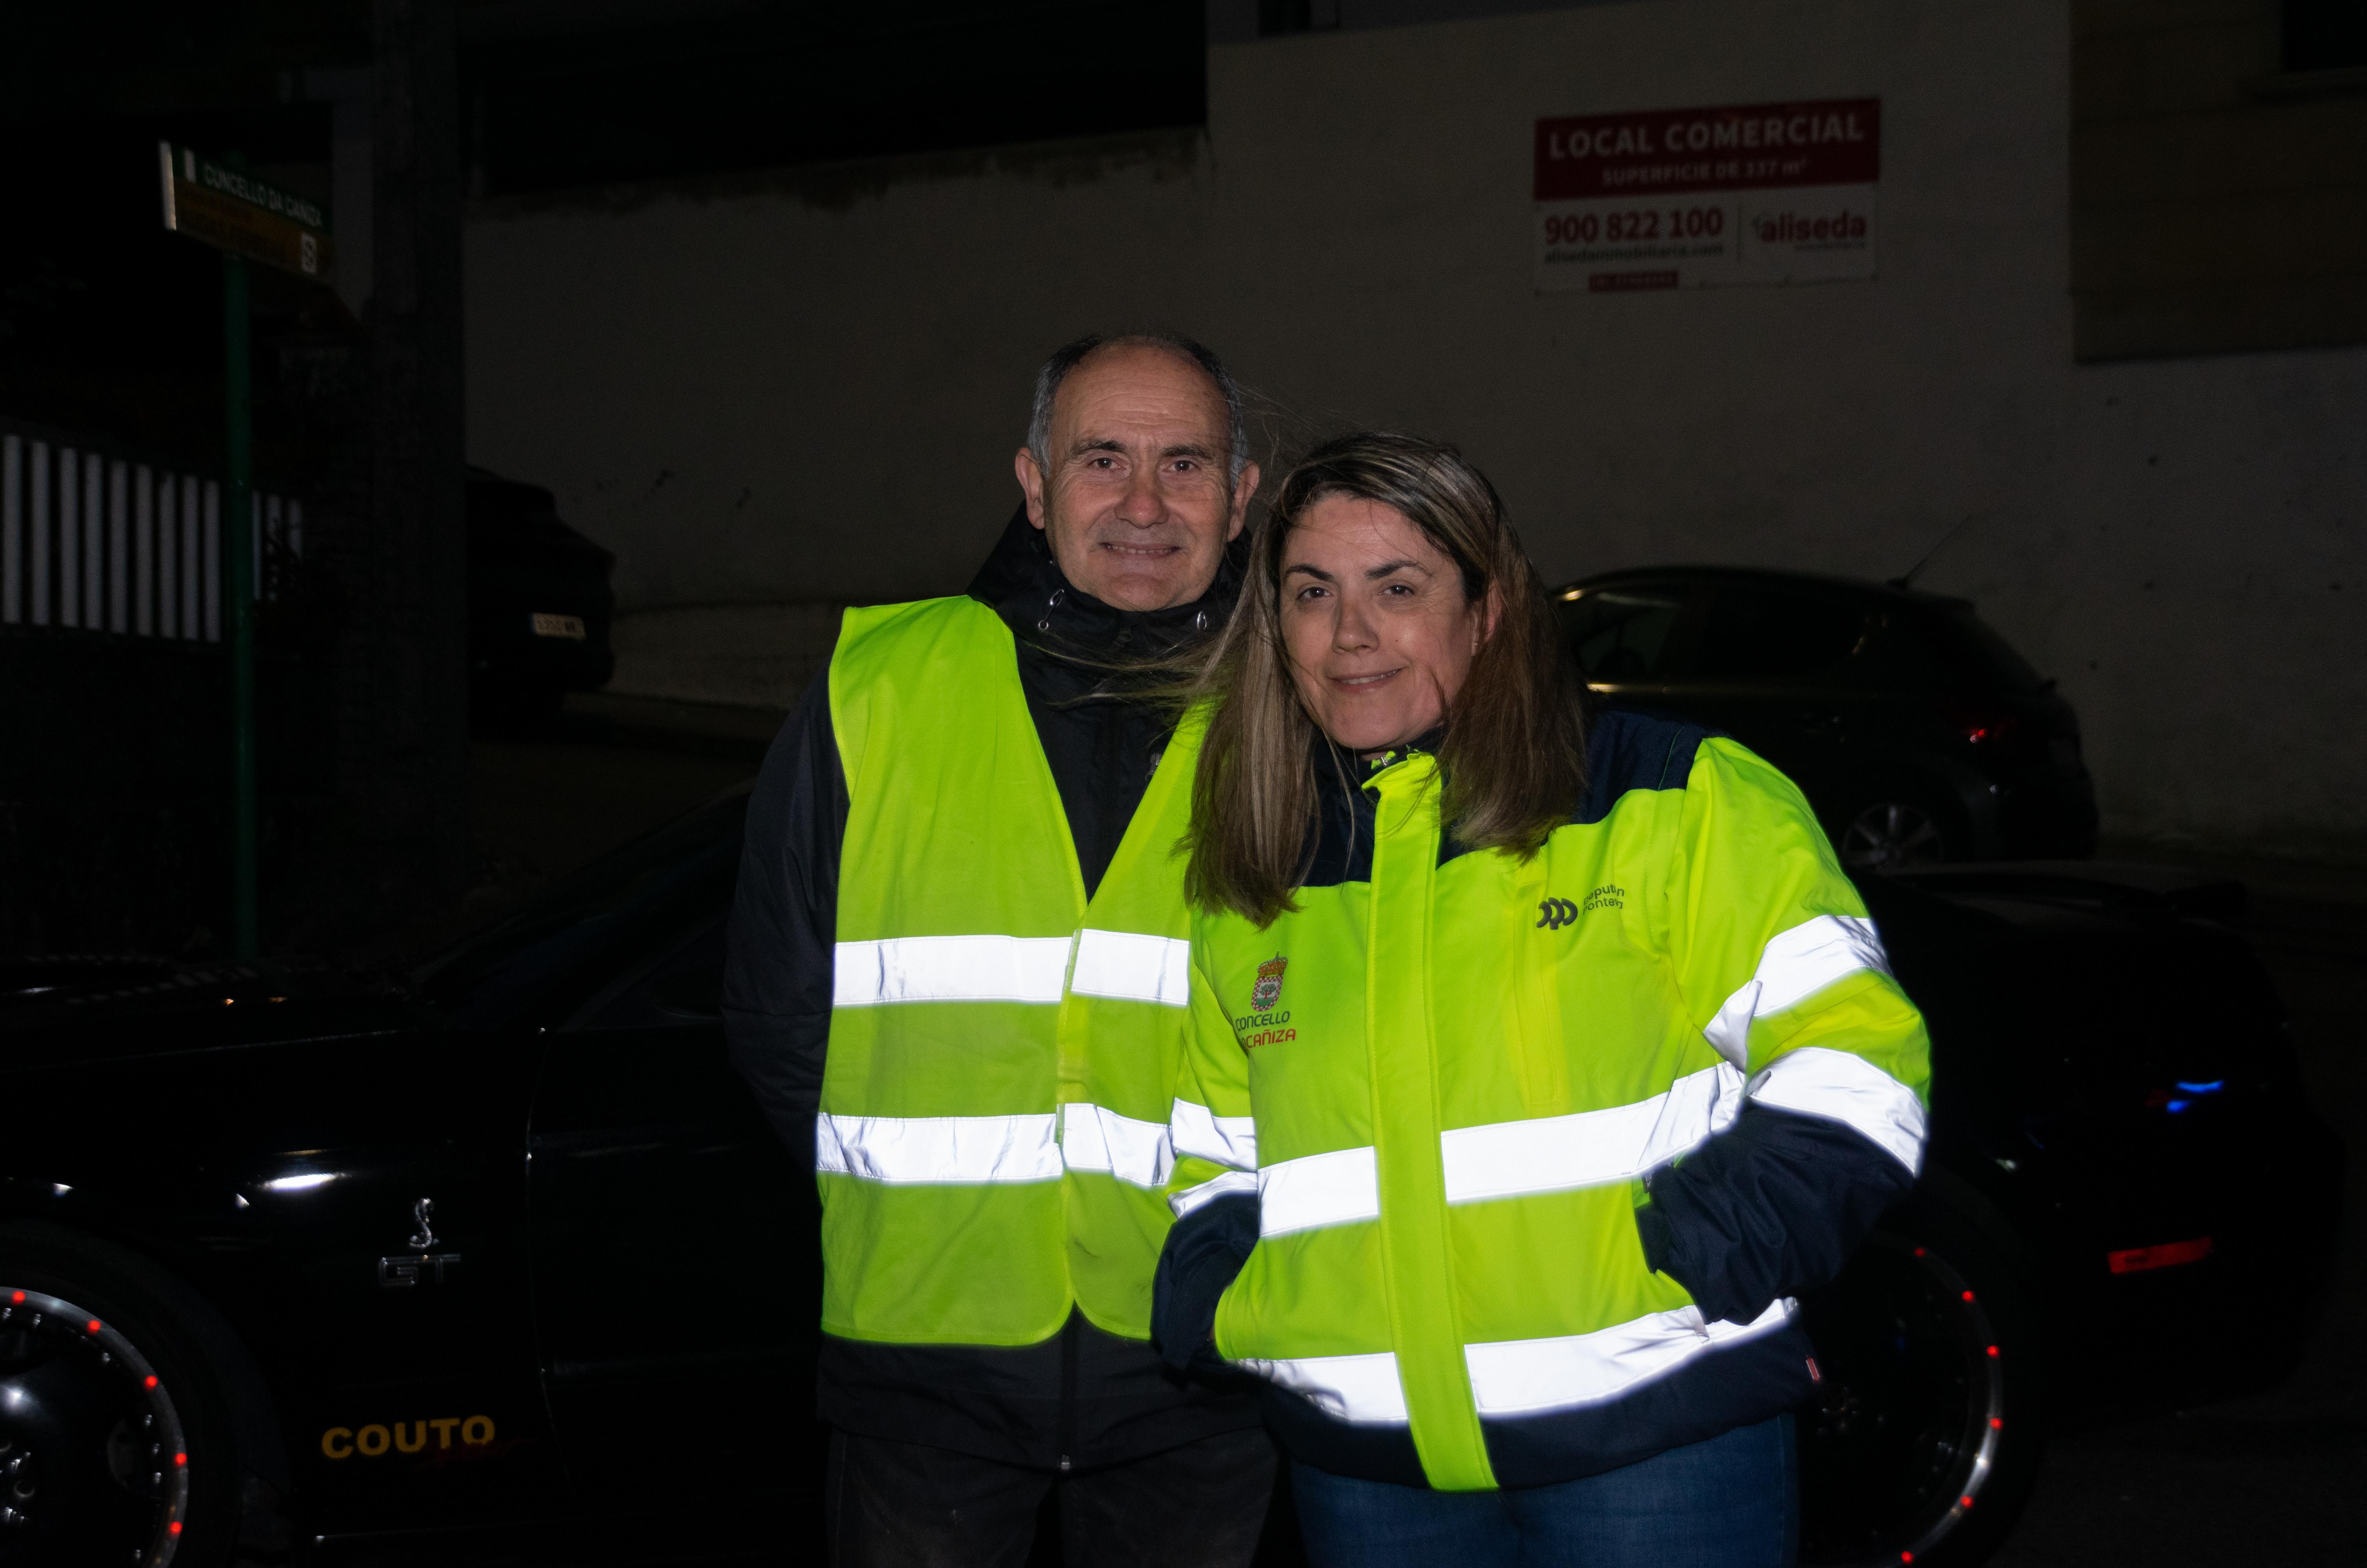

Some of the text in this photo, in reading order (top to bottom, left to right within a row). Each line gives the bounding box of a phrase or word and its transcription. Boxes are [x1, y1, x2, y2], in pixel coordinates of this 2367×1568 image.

[1548, 112, 1865, 159] LOCAL COMERCIAL
[203, 160, 266, 206] CONCELLO
[268, 187, 283, 211] DA
[1601, 161, 1710, 187] SUPERFICIE
[1715, 159, 1739, 179] DE
[1744, 159, 1777, 178] 337
[1545, 207, 1723, 245] 900 822 100
[1760, 209, 1867, 243] aliseda
[1235, 1010, 1290, 1032] CONCELLO
[378, 1253, 462, 1288] GT
[320, 1414, 497, 1460] COUTO
